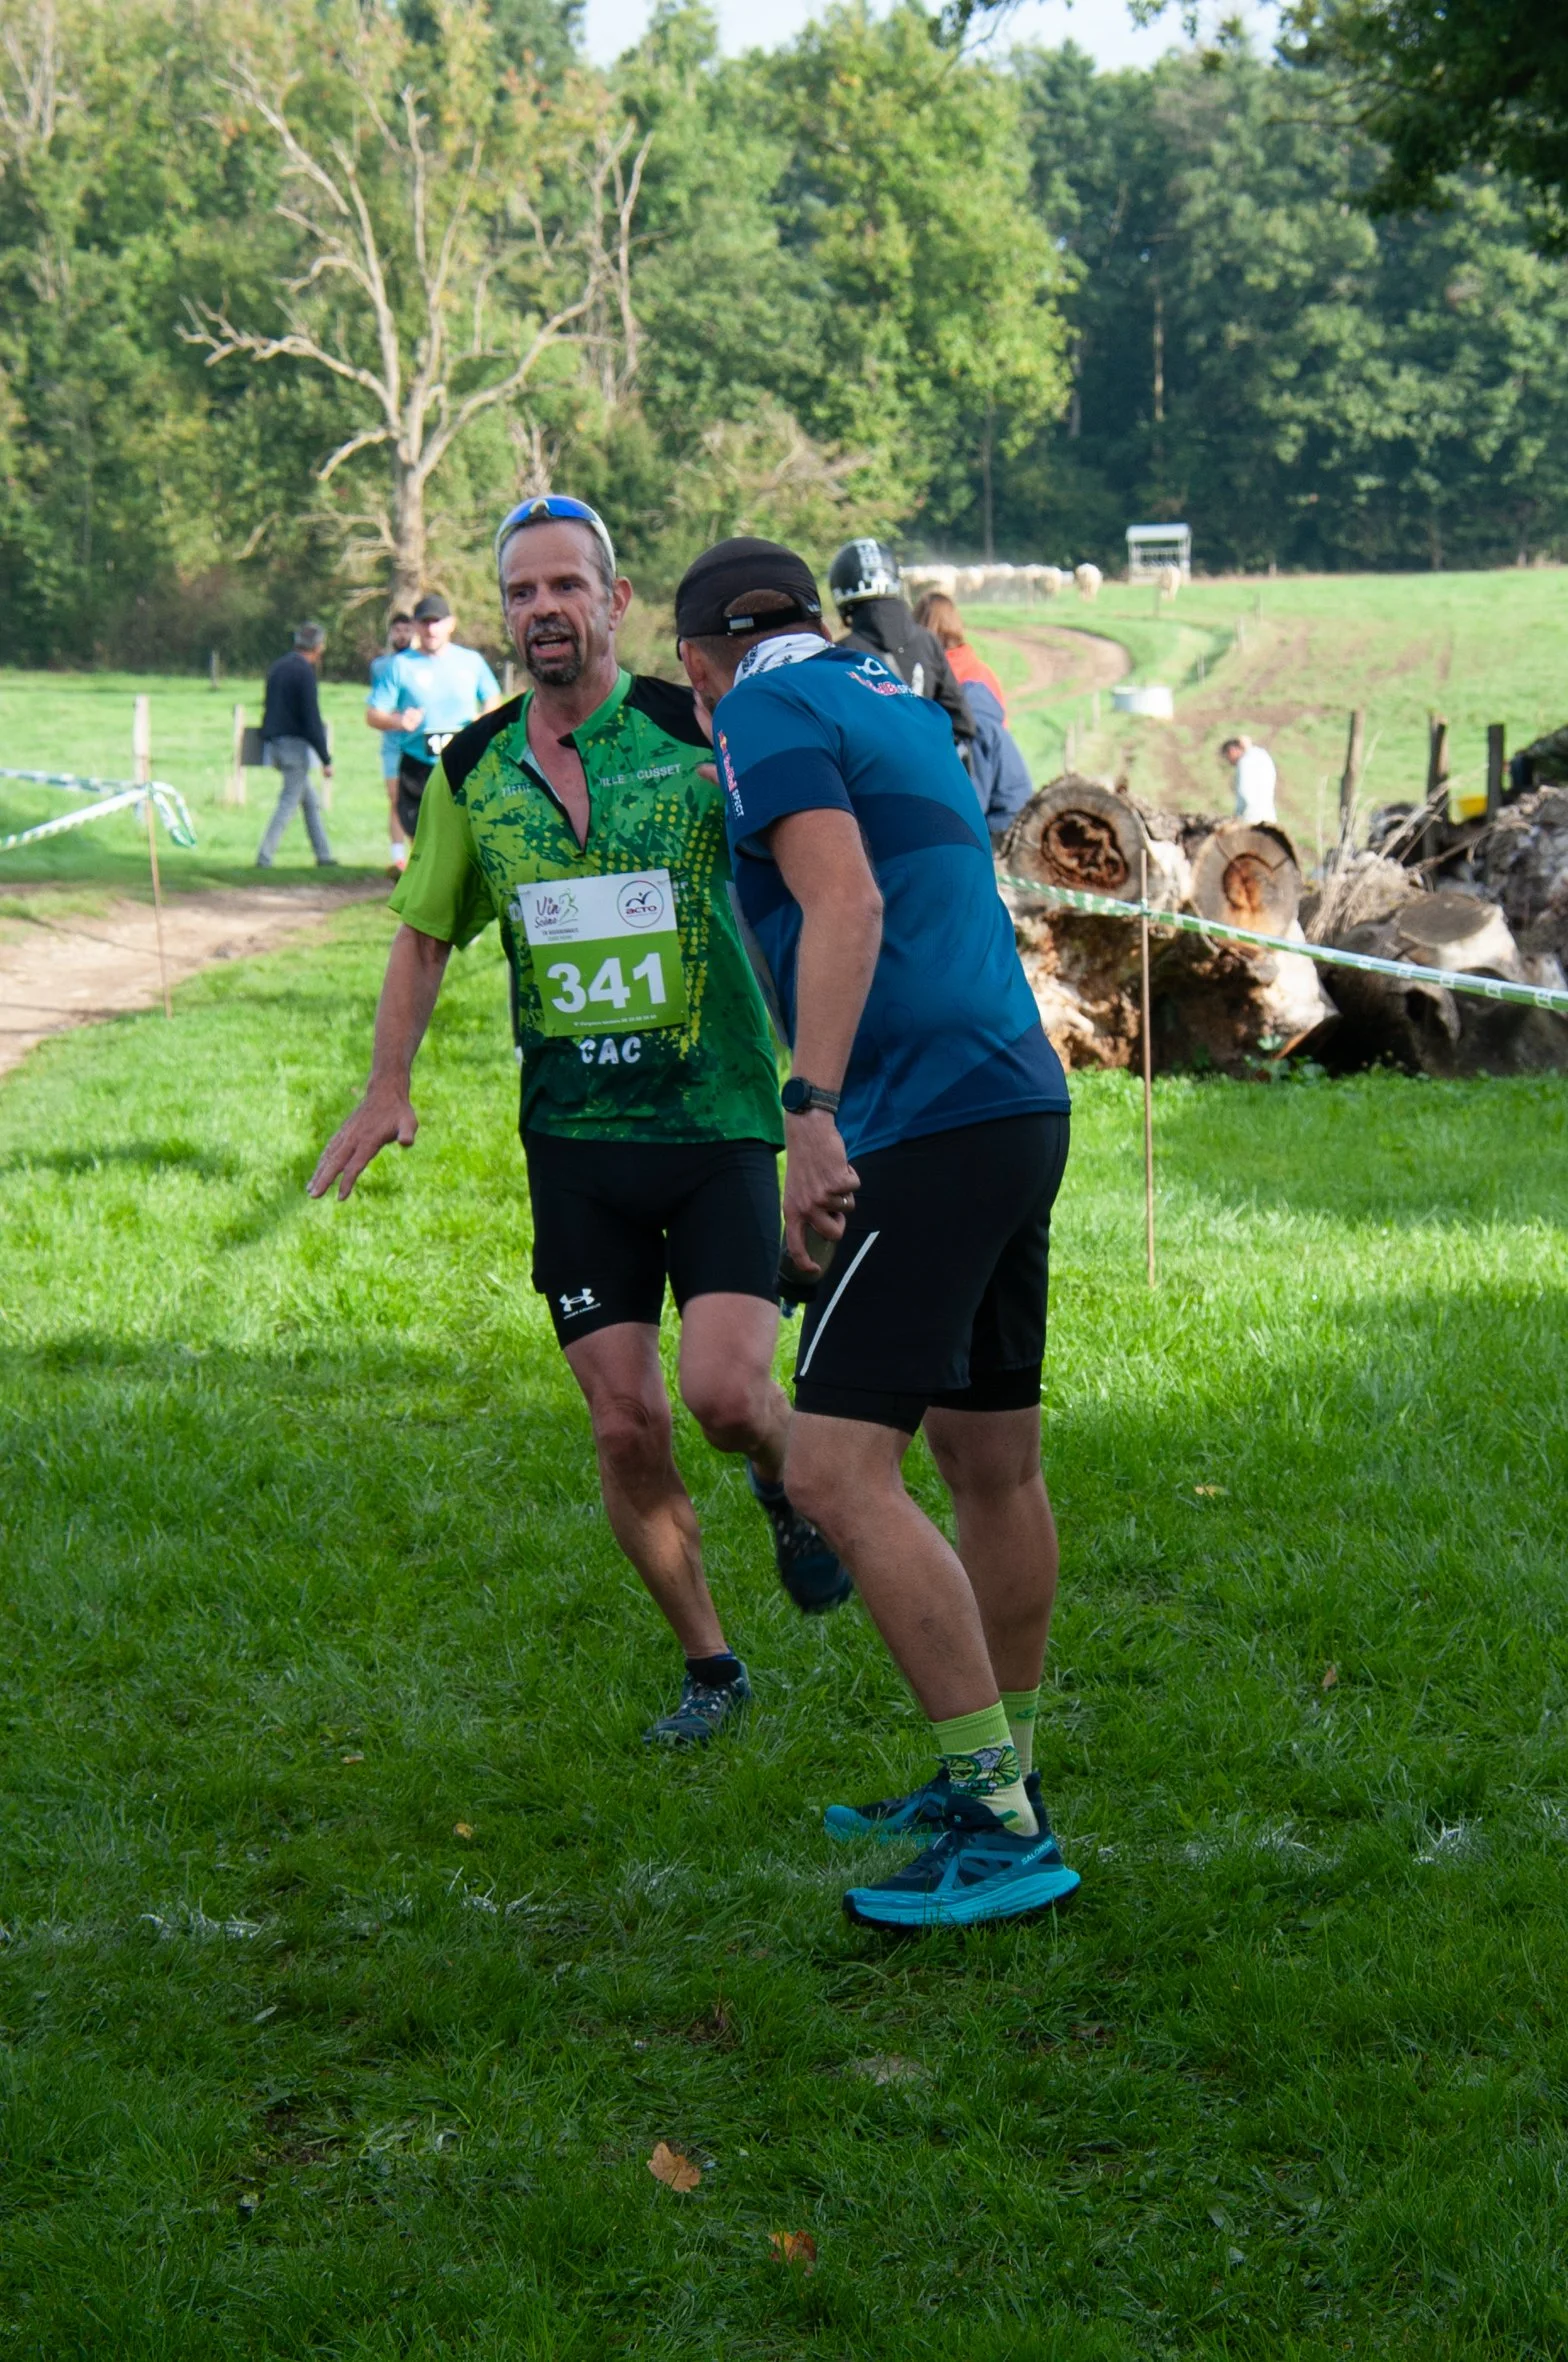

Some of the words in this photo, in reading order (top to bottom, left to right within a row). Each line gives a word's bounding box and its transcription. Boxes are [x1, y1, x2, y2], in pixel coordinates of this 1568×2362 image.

[636, 764, 682, 780] CUSSET
[536, 895, 560, 917] Vin
[547, 951, 667, 1013] 341
[579, 1036, 642, 1065] CAC
[1021, 1839, 1053, 1866] SALOMON
